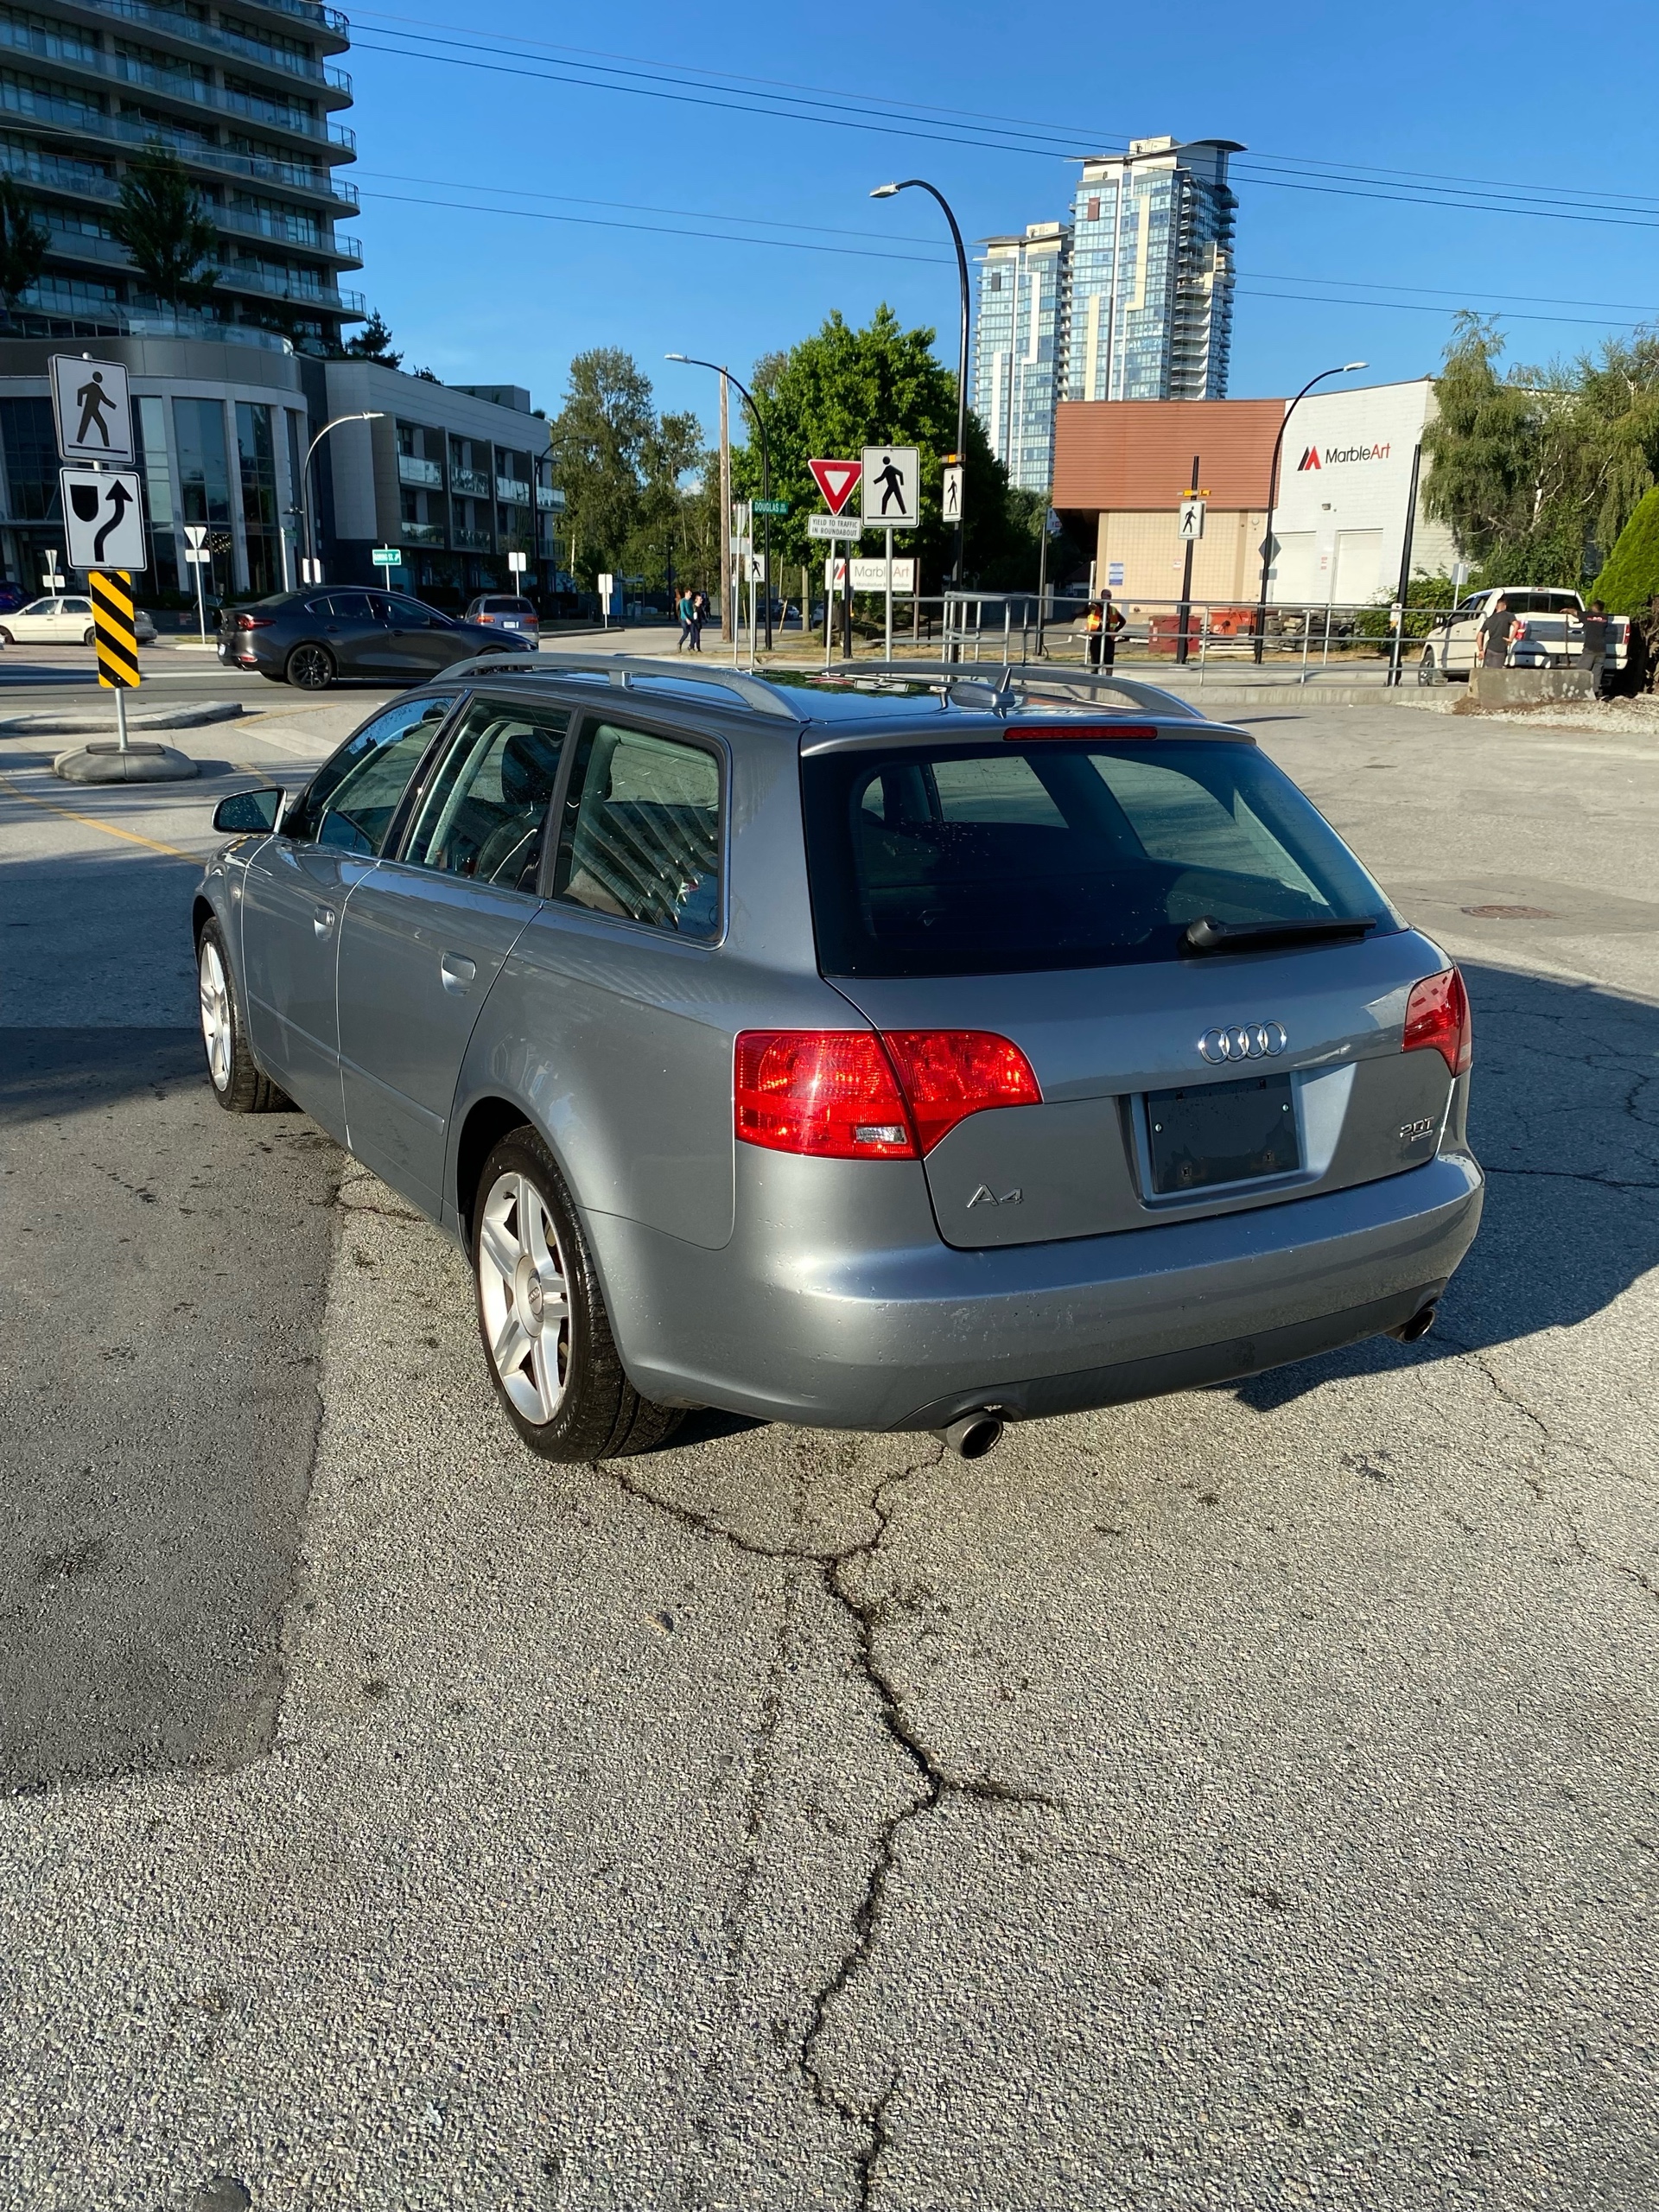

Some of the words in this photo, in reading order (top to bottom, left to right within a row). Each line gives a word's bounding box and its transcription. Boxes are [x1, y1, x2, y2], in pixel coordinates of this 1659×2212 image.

[1325, 442, 1391, 464] MarbleArt
[754, 501, 779, 512] DOUGLAS
[837, 520, 858, 529] TRAFFIC
[820, 527, 857, 537] ROUNDABOUT
[855, 565, 911, 578] MarblArt
[966, 1183, 1023, 1208] A4
